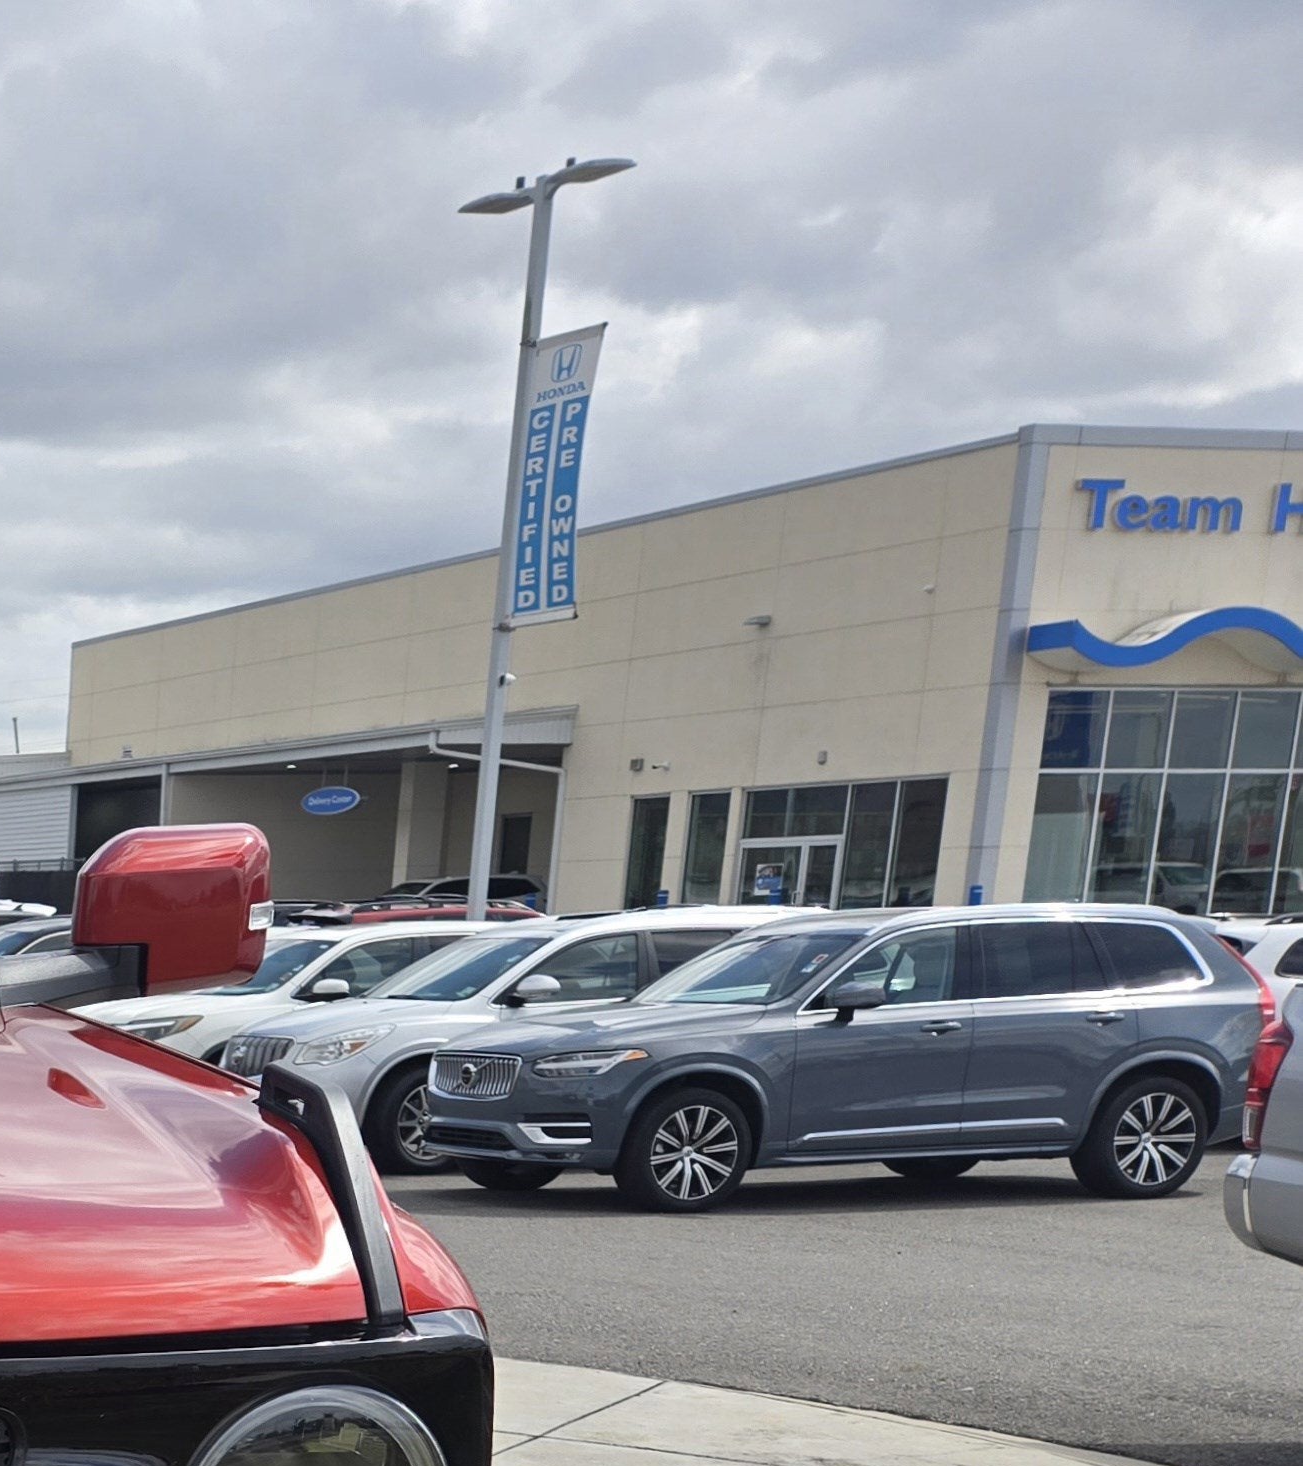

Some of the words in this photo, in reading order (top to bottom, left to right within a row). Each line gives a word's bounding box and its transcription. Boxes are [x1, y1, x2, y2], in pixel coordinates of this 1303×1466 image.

[535, 381, 586, 403] HONDA
[559, 401, 582, 469] PRE
[516, 410, 551, 609] CERTIFIED
[1077, 478, 1244, 532] Team
[551, 494, 574, 604] OWNED
